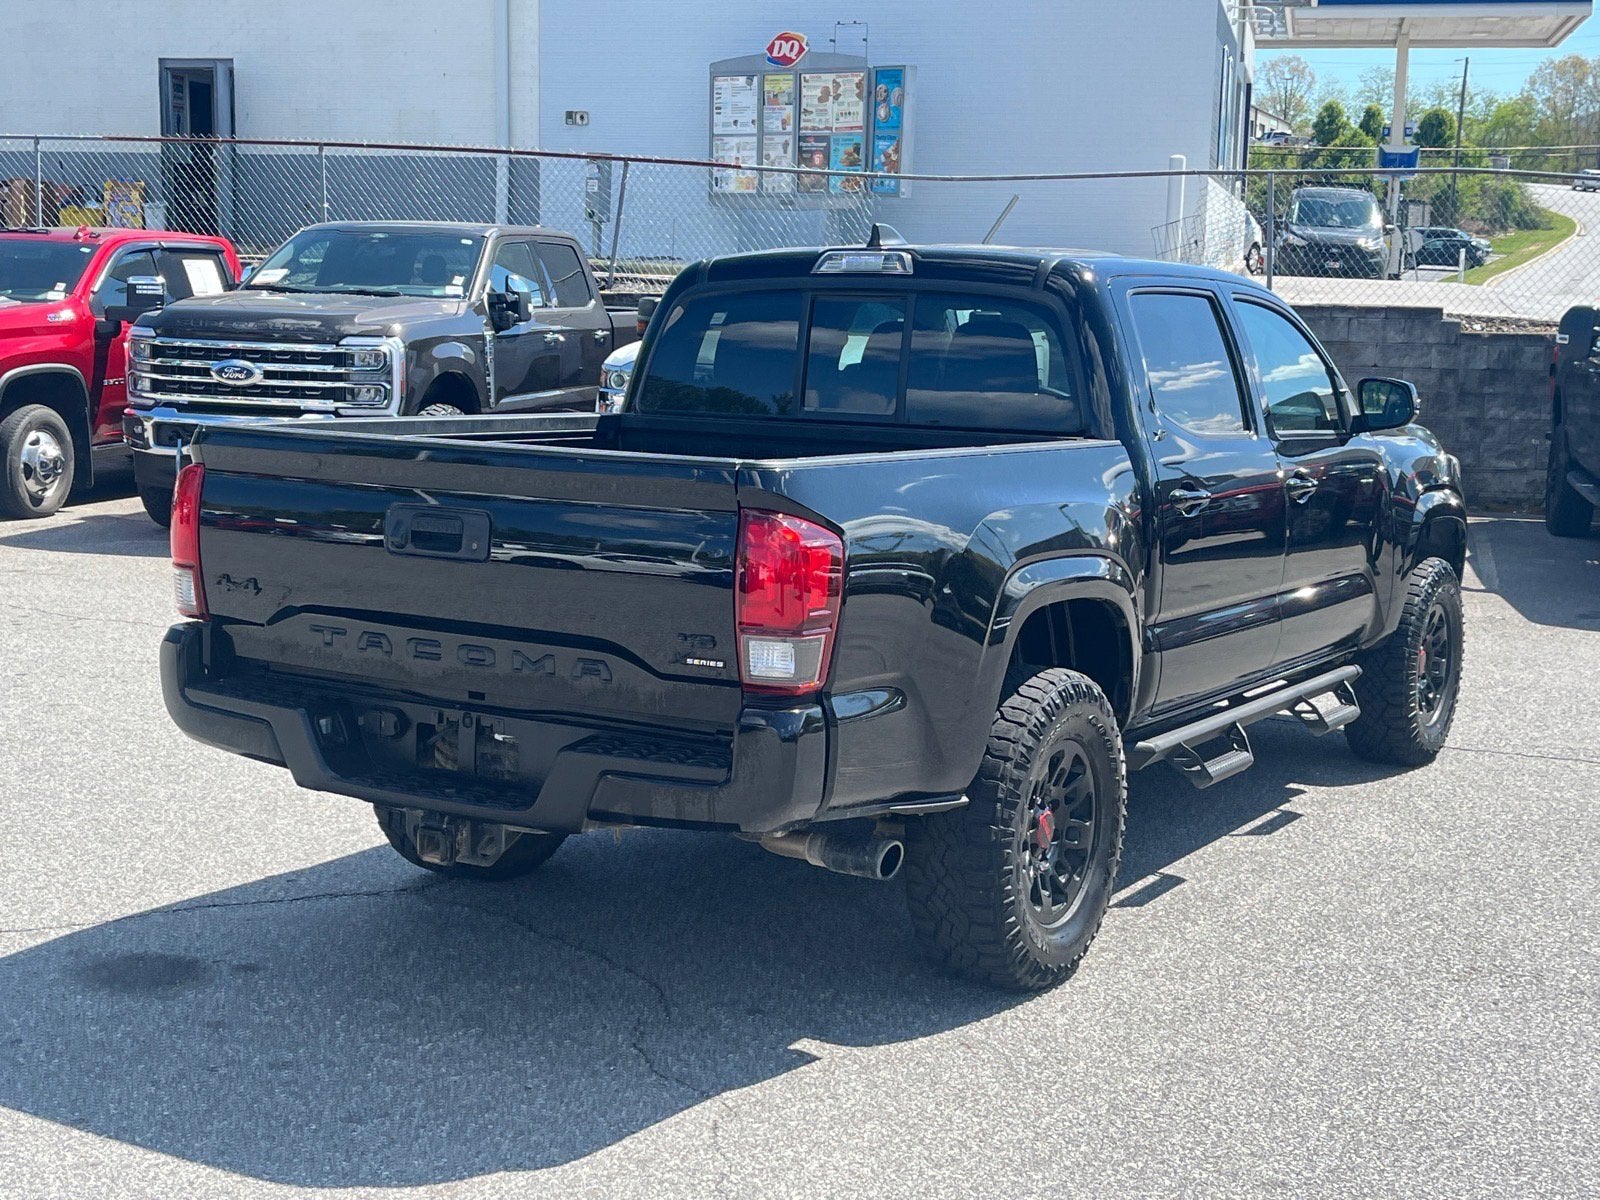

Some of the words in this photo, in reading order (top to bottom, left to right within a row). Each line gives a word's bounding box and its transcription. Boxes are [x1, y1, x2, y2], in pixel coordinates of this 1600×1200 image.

[771, 39, 800, 59] DQ
[221, 366, 247, 379] Ford
[308, 623, 613, 683] TACOMA
[686, 657, 724, 668] SERIES
